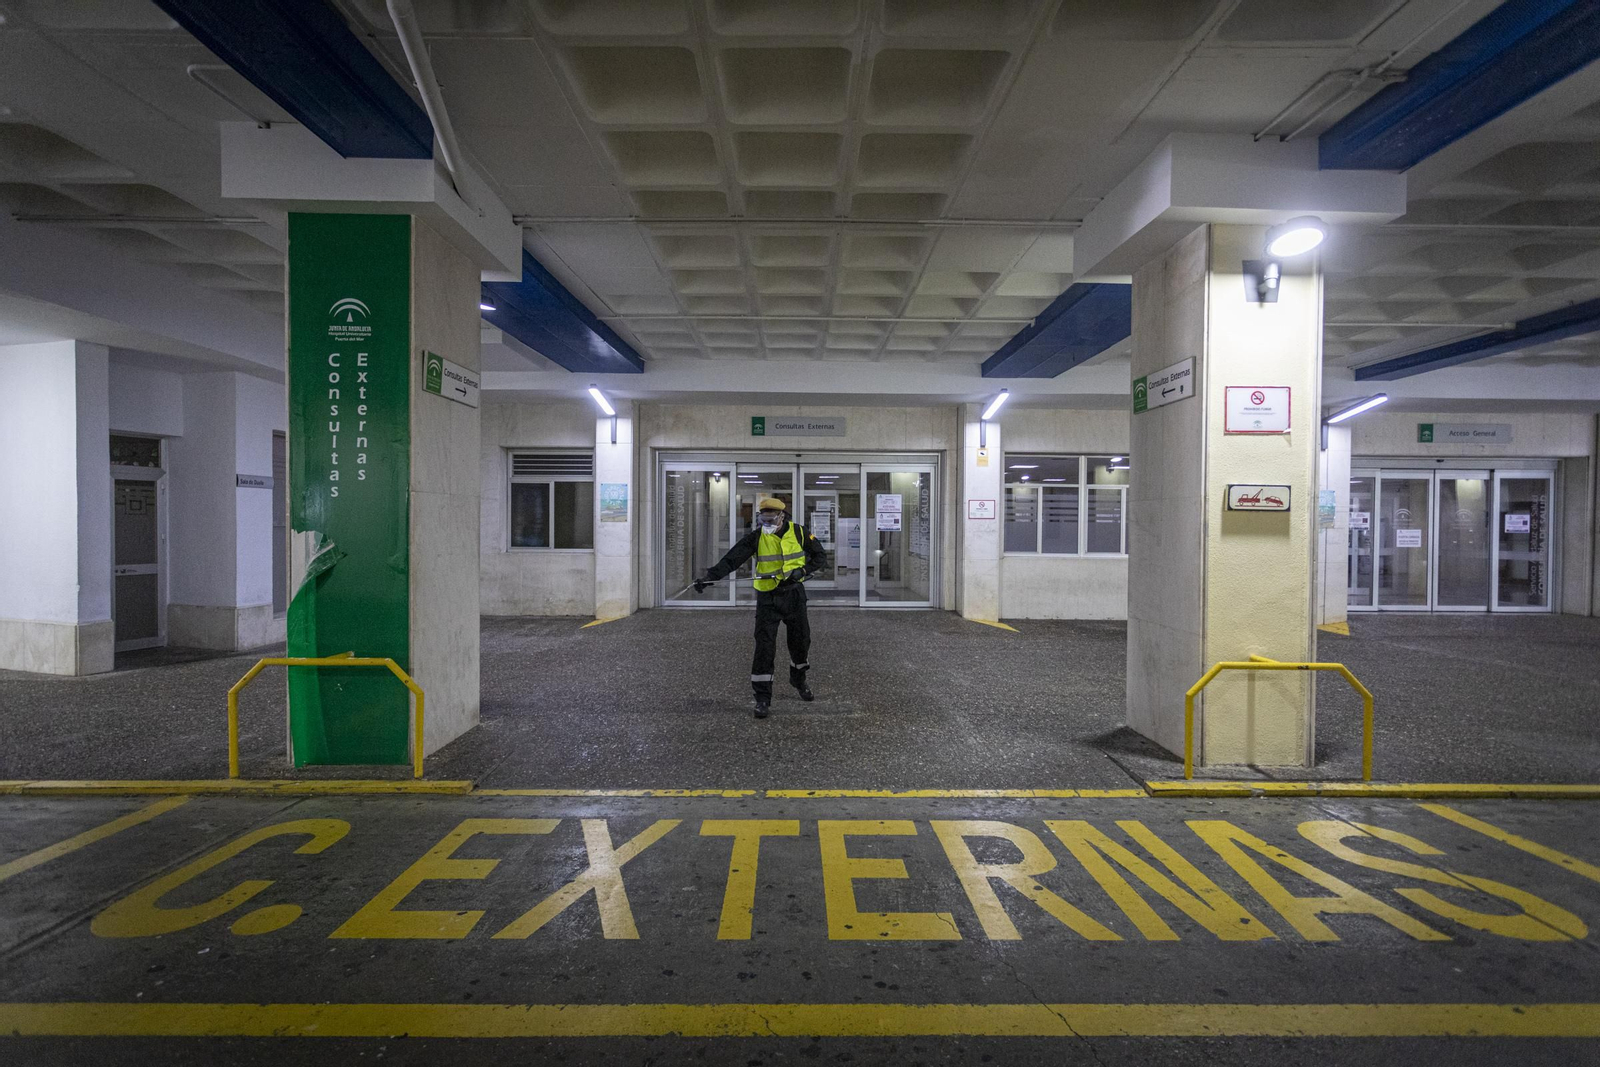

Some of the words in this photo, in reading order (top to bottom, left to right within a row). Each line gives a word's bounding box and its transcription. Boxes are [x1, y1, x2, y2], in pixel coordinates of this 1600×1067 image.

[444, 367, 462, 383] Consultas
[463, 376, 478, 389] Externas
[1148, 376, 1169, 390] Consultas
[1170, 368, 1191, 382] Externas
[328, 353, 341, 498] Consultas
[356, 352, 369, 481] Externas
[677, 485, 685, 514] SALUD
[921, 488, 929, 519] SALUD
[327, 818, 1590, 943] EXTERNAS
